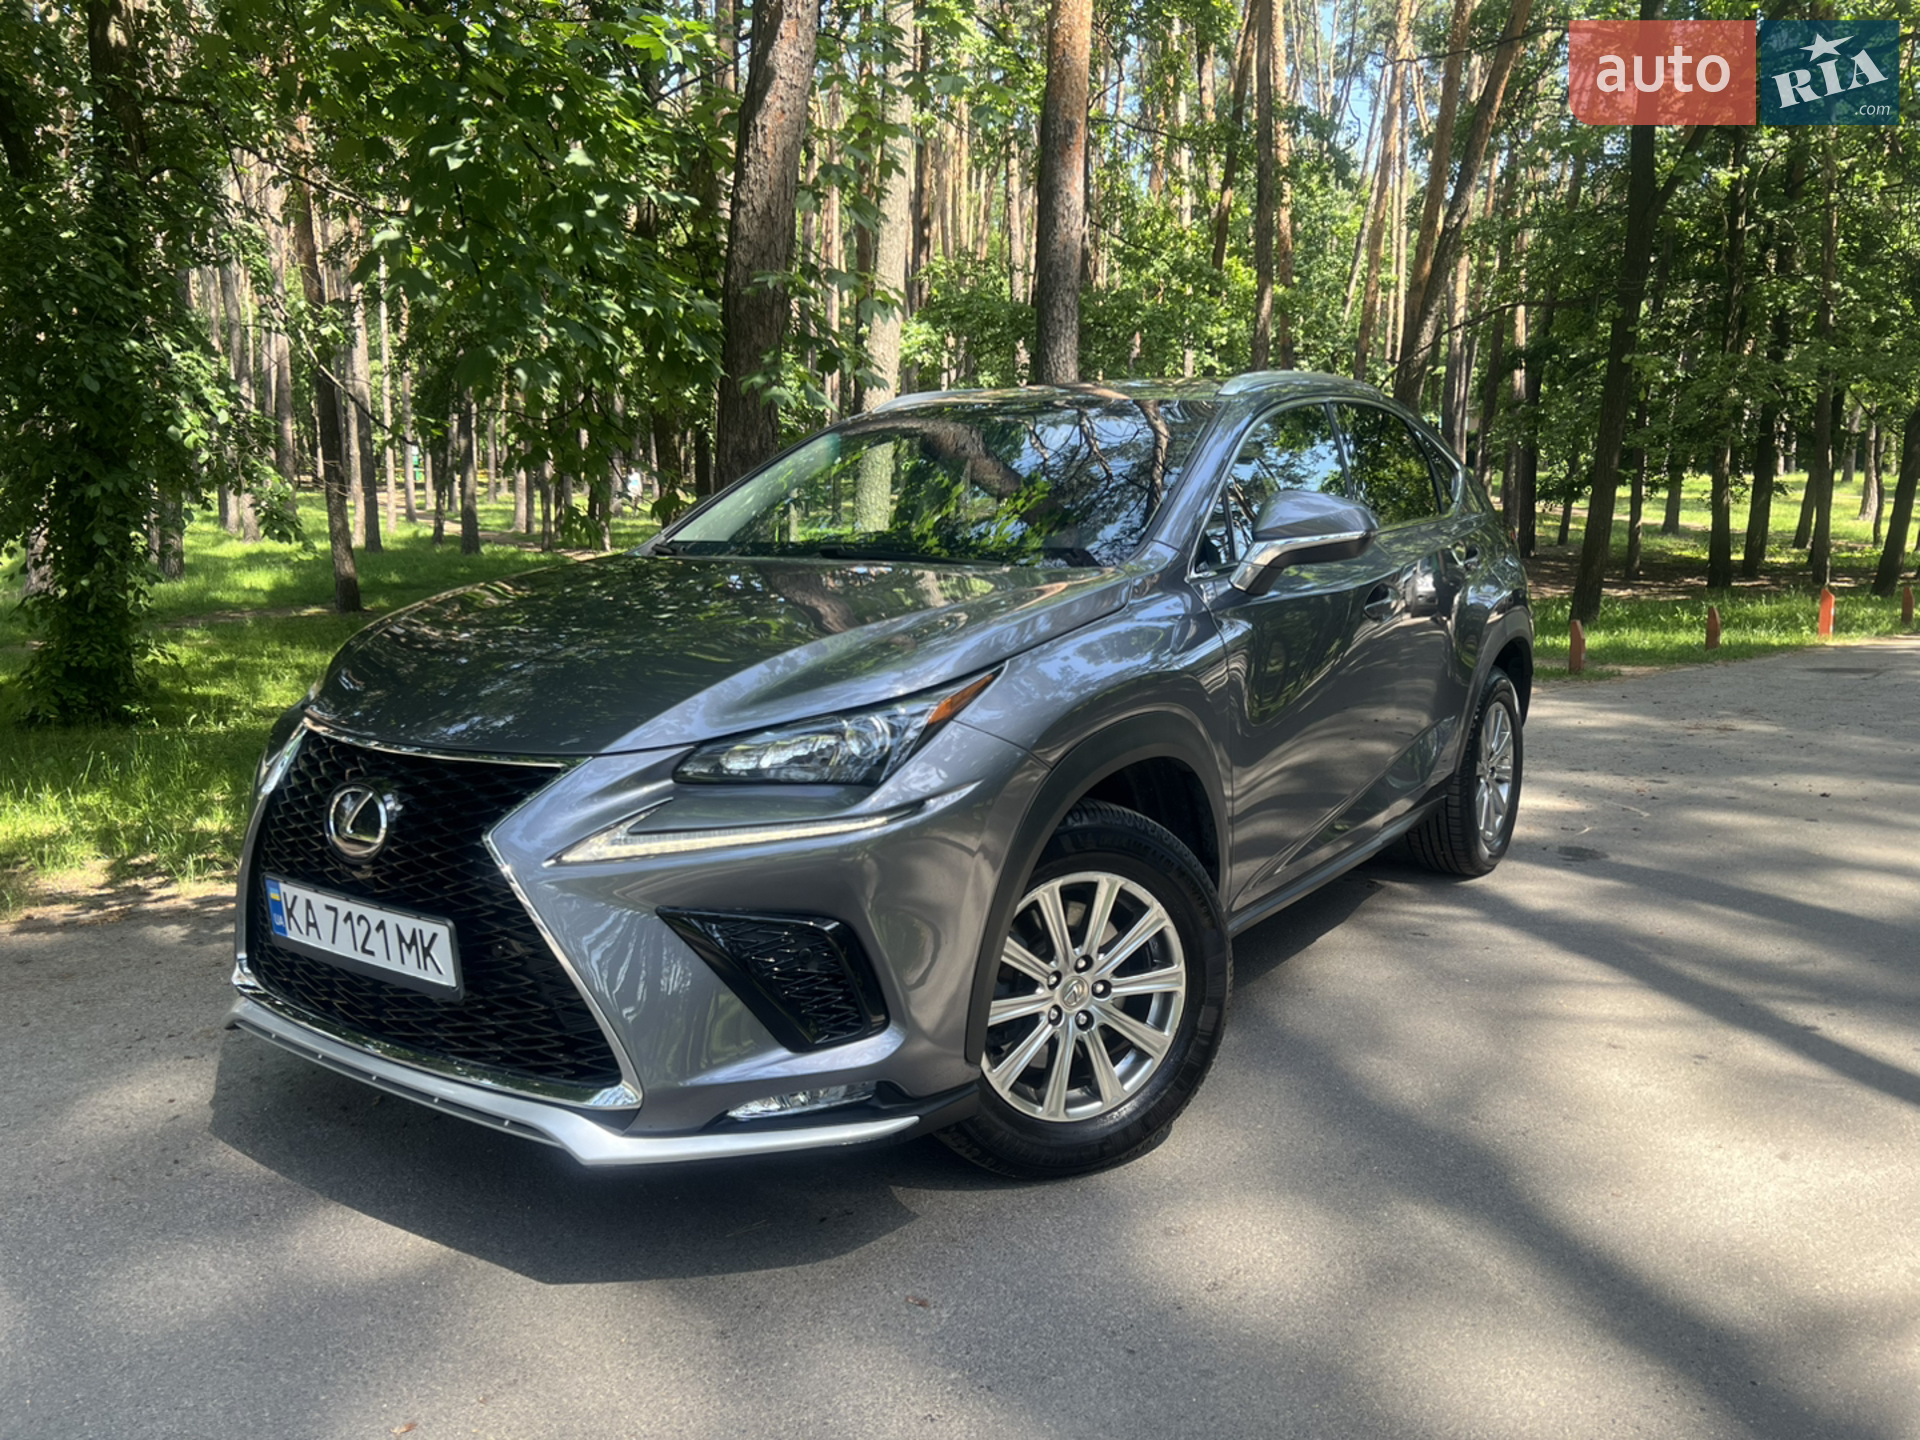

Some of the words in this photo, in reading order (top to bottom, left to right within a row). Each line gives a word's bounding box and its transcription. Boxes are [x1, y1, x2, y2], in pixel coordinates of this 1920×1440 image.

[283, 891, 322, 940] KA
[324, 903, 391, 962] 7121
[395, 922, 445, 976] MK
